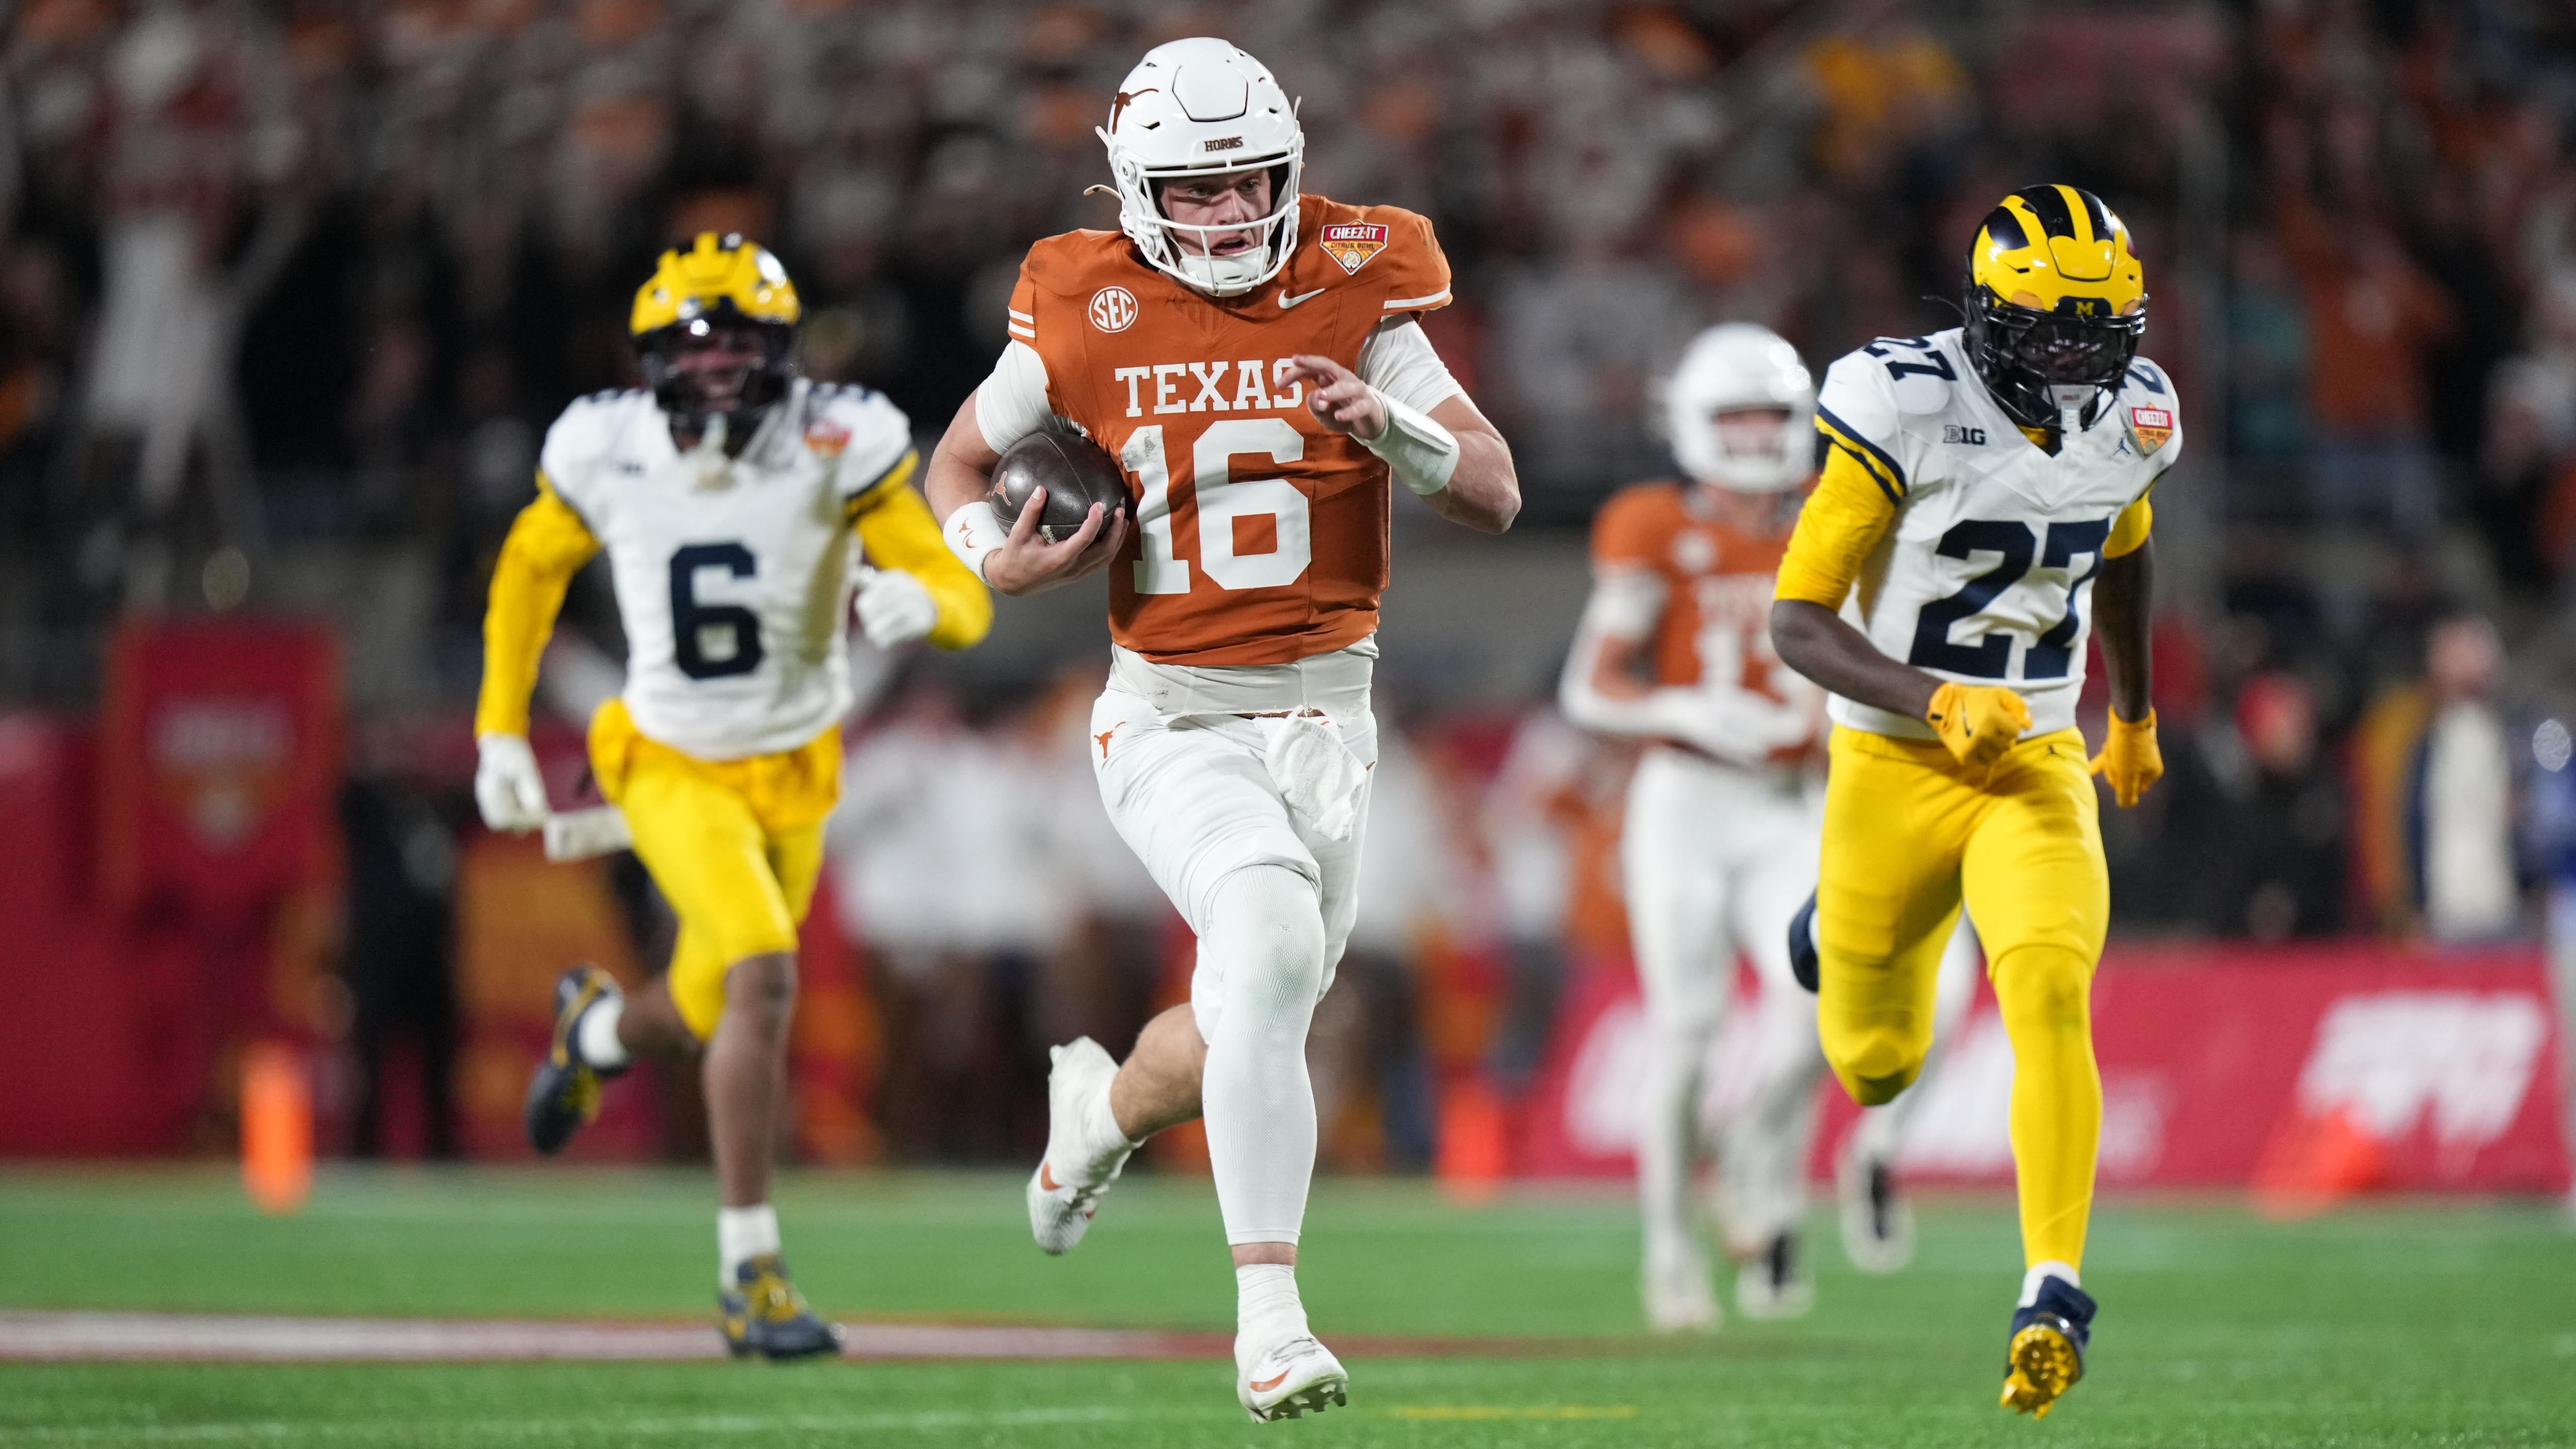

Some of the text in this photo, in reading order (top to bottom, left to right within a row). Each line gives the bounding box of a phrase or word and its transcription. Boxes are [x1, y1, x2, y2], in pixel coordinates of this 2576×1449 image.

[1204, 136, 1243, 151] HORNS
[1094, 290, 1133, 329] SEC
[2075, 301, 2095, 315] M
[1114, 358, 1302, 418] TEXAS
[1121, 418, 1312, 590] 16
[670, 543, 763, 679] 6
[1909, 515, 2109, 680] 27
